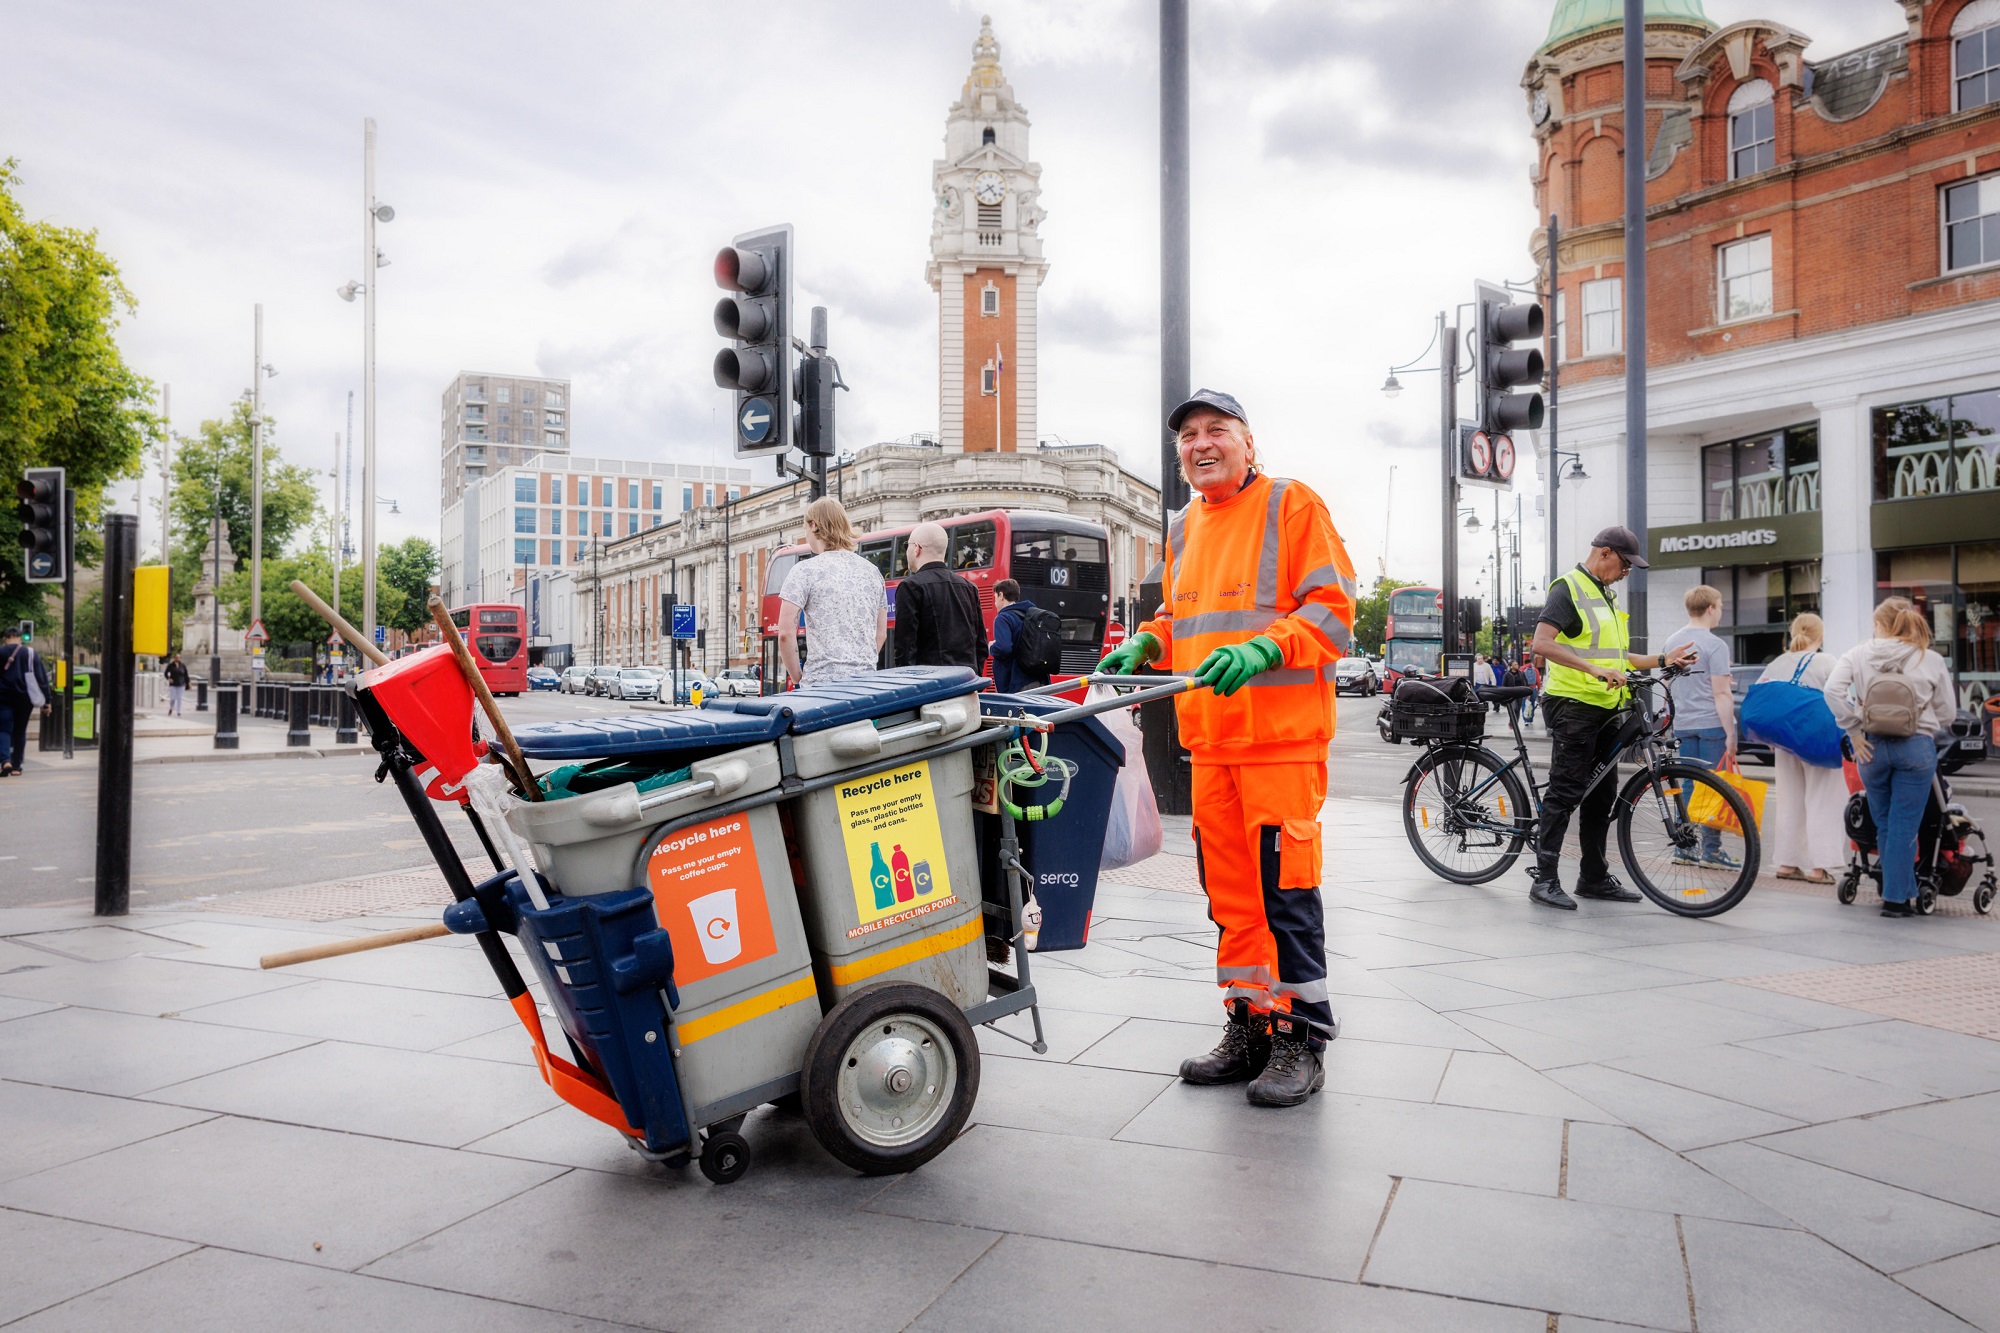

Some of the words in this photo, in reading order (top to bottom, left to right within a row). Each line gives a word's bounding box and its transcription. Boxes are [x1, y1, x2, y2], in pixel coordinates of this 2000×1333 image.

[1660, 529, 1777, 553] McDonald's
[1050, 568, 1068, 585] 109
[842, 778, 892, 799] Recycle
[893, 770, 922, 784] here
[850, 808, 869, 818] Pass
[882, 800, 898, 810] your
[900, 792, 922, 804] empty
[850, 817, 873, 829] glass,
[873, 809, 898, 822] plastic
[898, 801, 924, 814] bottles
[709, 822, 741, 839] here
[873, 820, 887, 831] and
[888, 816, 908, 827] cans.
[661, 865, 682, 876] Pass
[683, 861, 696, 870] me
[697, 854, 715, 866] your
[717, 846, 741, 859] empty
[679, 868, 706, 881] coffee
[707, 860, 729, 873] cups.
[1040, 873, 1079, 887] serco
[848, 920, 883, 939] MOBILE
[883, 903, 931, 927] RECYCLING
[931, 895, 958, 911] POINT
